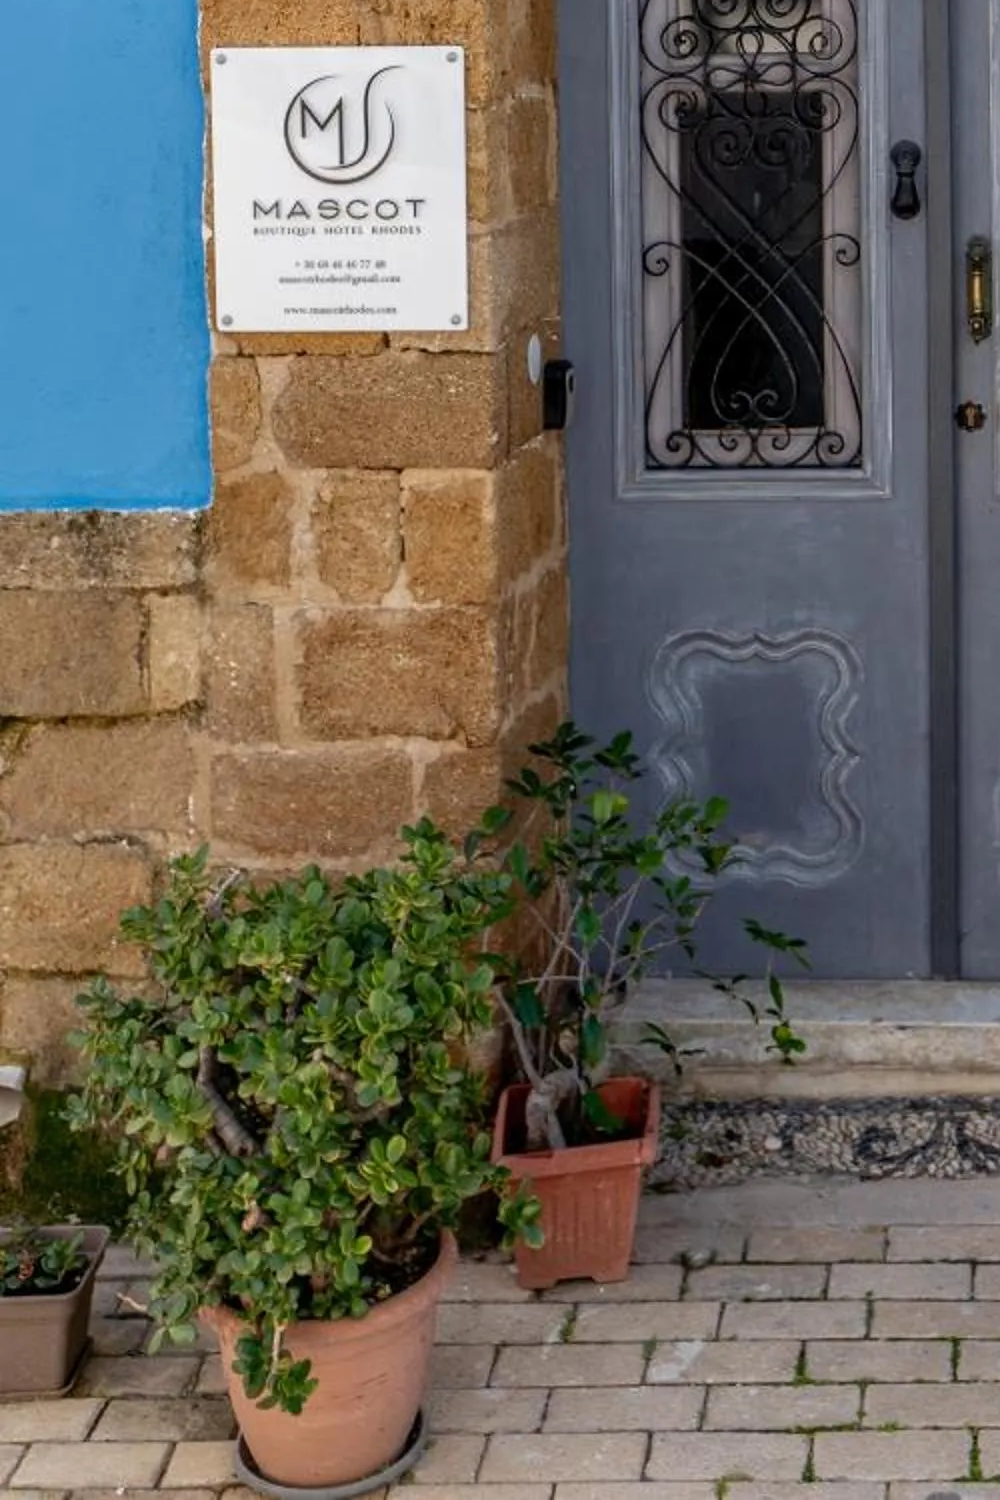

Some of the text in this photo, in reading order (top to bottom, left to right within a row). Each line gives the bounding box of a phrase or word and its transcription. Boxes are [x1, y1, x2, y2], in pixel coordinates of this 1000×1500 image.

[252, 198, 426, 220] MASCOT
[252, 225, 422, 236] BOUTIQUE HOTEL RHODES
